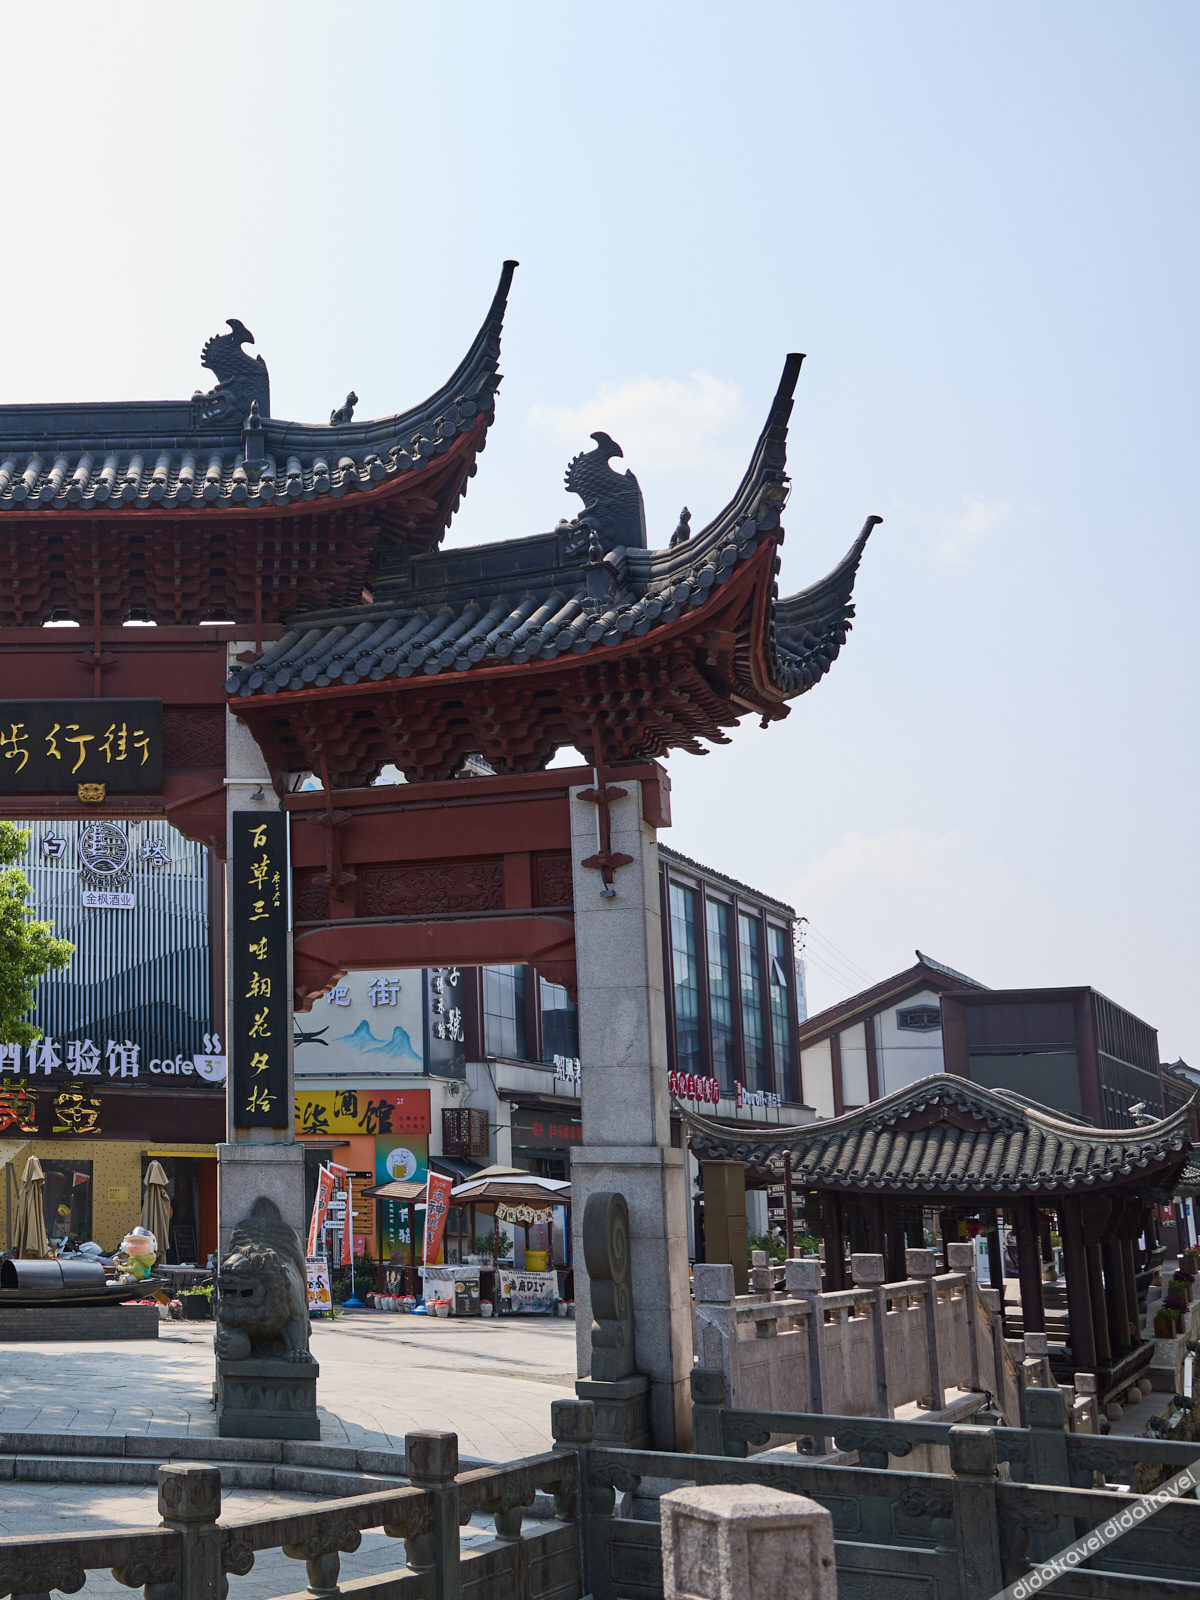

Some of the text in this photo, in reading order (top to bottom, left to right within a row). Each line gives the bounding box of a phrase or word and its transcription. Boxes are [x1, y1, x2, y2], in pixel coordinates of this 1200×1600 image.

[81, 870, 110, 888] SINCE
[85, 893, 131, 906] 金枫酒业
[245, 823, 278, 1113] 百草三味朝花夕拾
[149, 1057, 194, 1076] cafe
[670, 1074, 720, 1102] 文化主题餐厅
